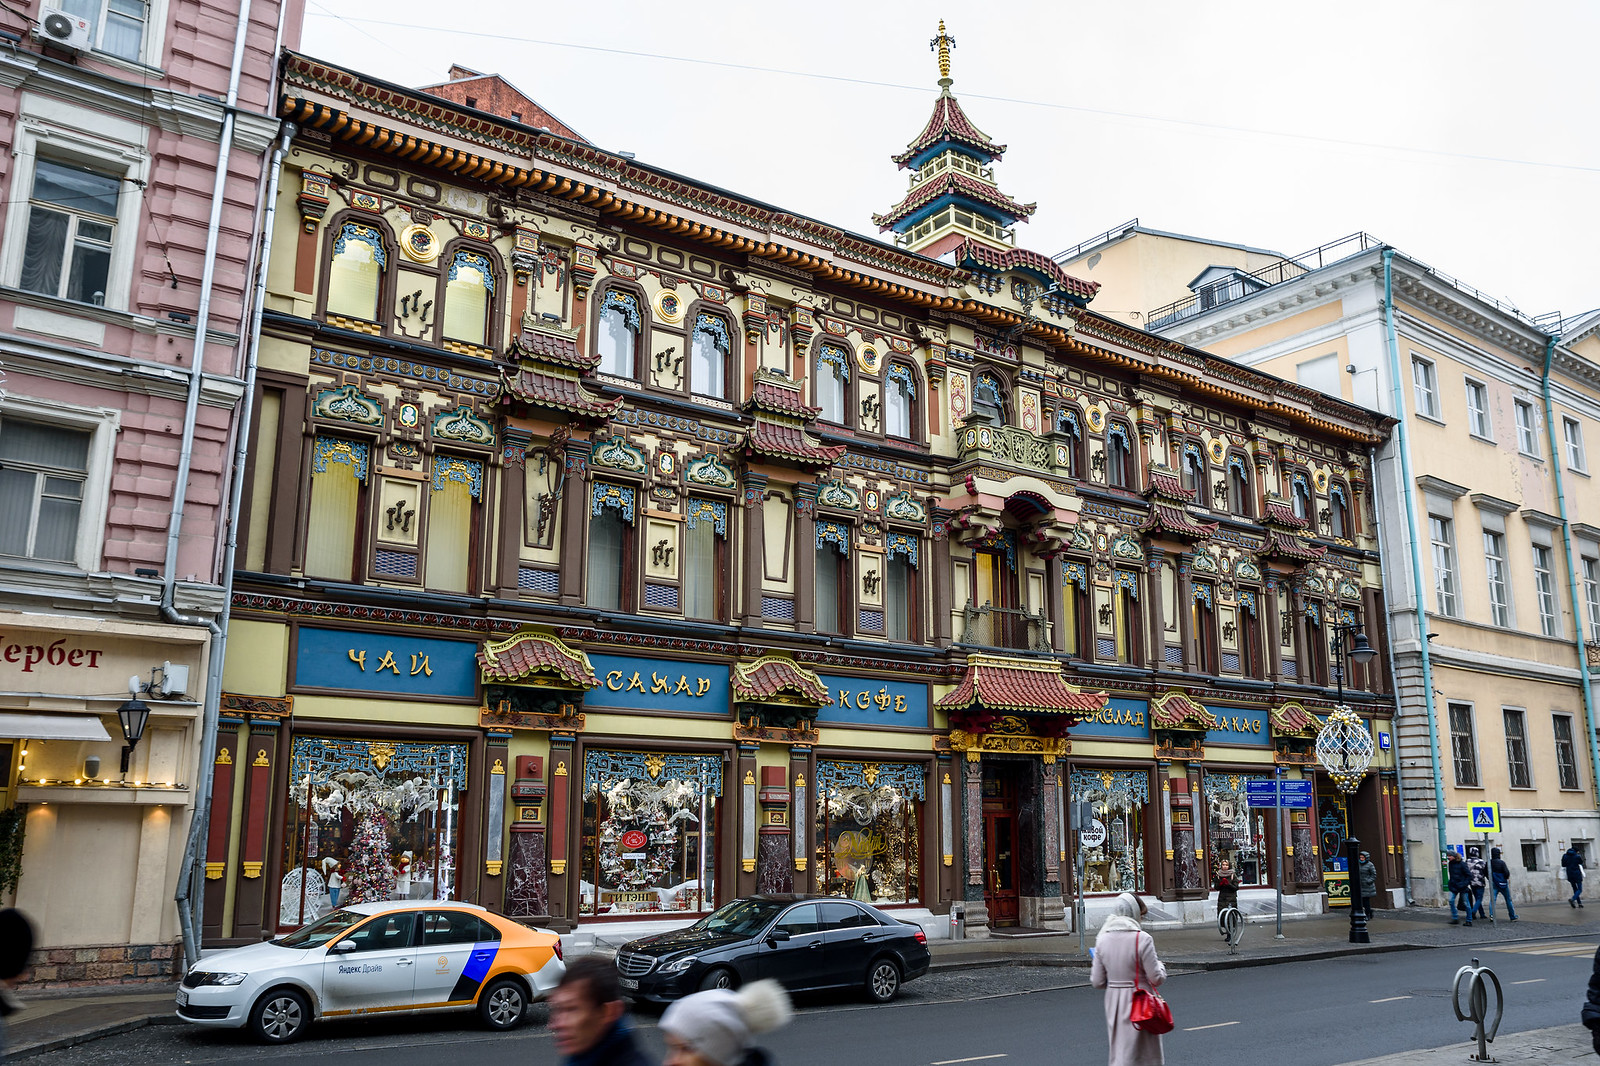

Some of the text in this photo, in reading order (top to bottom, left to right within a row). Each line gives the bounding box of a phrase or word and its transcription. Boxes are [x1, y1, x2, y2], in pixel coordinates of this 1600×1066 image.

[0, 636, 103, 673] ербет
[348, 649, 434, 677] ЧАЙ
[606, 671, 711, 697] САХАР
[839, 687, 908, 713] КОФЕ
[1214, 716, 1261, 734] АКАО
[1382, 735, 1389, 745] 19
[1083, 834, 1102, 843] кофе
[625, 893, 652, 902] ТЭНГ
[338, 963, 383, 975] Яндекс Драйв
